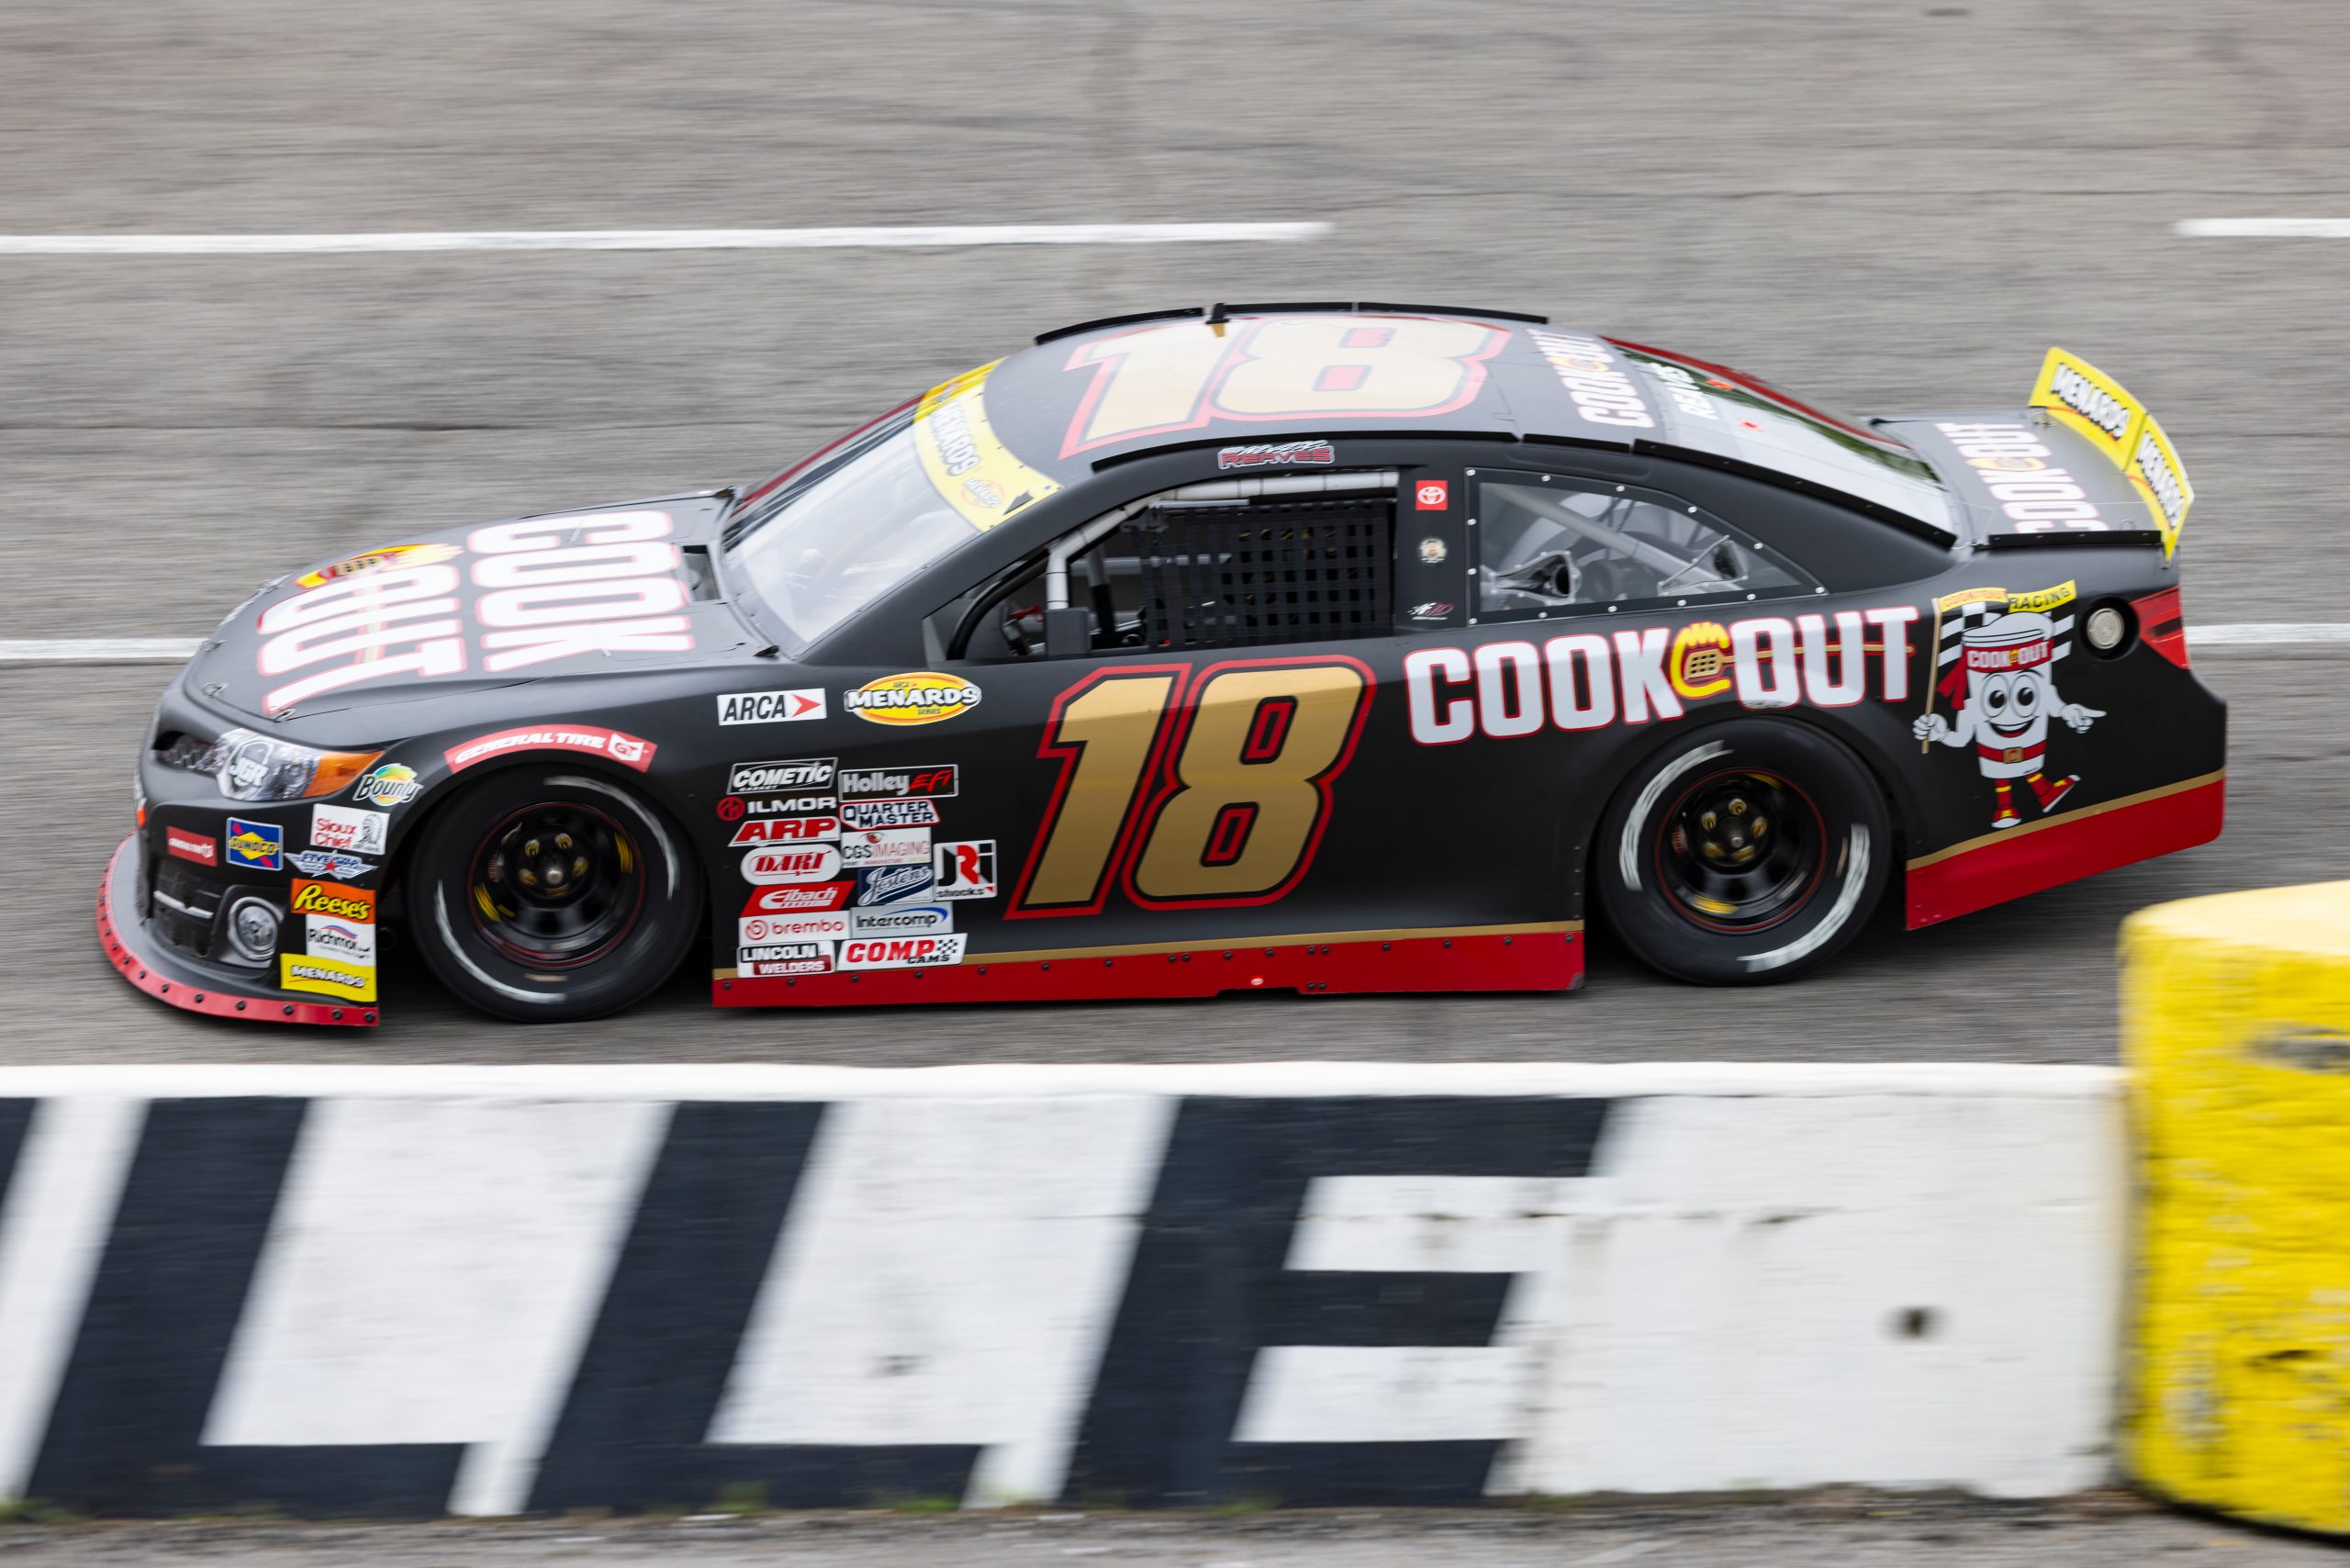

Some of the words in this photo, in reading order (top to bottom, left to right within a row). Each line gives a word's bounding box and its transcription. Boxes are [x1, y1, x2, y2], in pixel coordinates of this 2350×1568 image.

[1058, 314, 1512, 461] 18
[2051, 362, 2132, 441] MENARDS
[929, 398, 981, 476] MENARDS
[1219, 445, 1334, 466] REAVES
[466, 510, 695, 673] COOK
[2009, 587, 2071, 610] RACING
[257, 563, 466, 716] OUT
[1404, 627, 1685, 746] COOK
[1729, 606, 1920, 710] OUT
[722, 694, 787, 722] ARCA
[847, 687, 979, 709] MENARDS
[554, 734, 608, 750] TIRE
[229, 756, 269, 787] JGR
[733, 765, 834, 789] COMETIC
[353, 772, 425, 803] Bounty
[843, 771, 911, 797] Holley
[1003, 655, 1377, 921] 18
[746, 796, 837, 814] ILMOR
[844, 801, 929, 822] QUARTER
[316, 817, 356, 834] Sioux
[734, 818, 837, 842] ARP
[858, 812, 934, 828] MASTER
[229, 835, 279, 855] SUNOCO
[314, 832, 352, 849] Chief
[753, 851, 833, 873] DART
[759, 887, 840, 909] Eibach
[936, 888, 985, 898] shocks
[772, 918, 845, 935] brembo
[856, 913, 937, 928] Intercomp
[742, 945, 818, 963] LINCOLN
[845, 939, 935, 963] COMP
[907, 954, 951, 965] CAMS
[291, 964, 365, 989] MENARDS
[759, 960, 826, 974] WELDERS
[0, 1095, 1620, 1519] LLE
